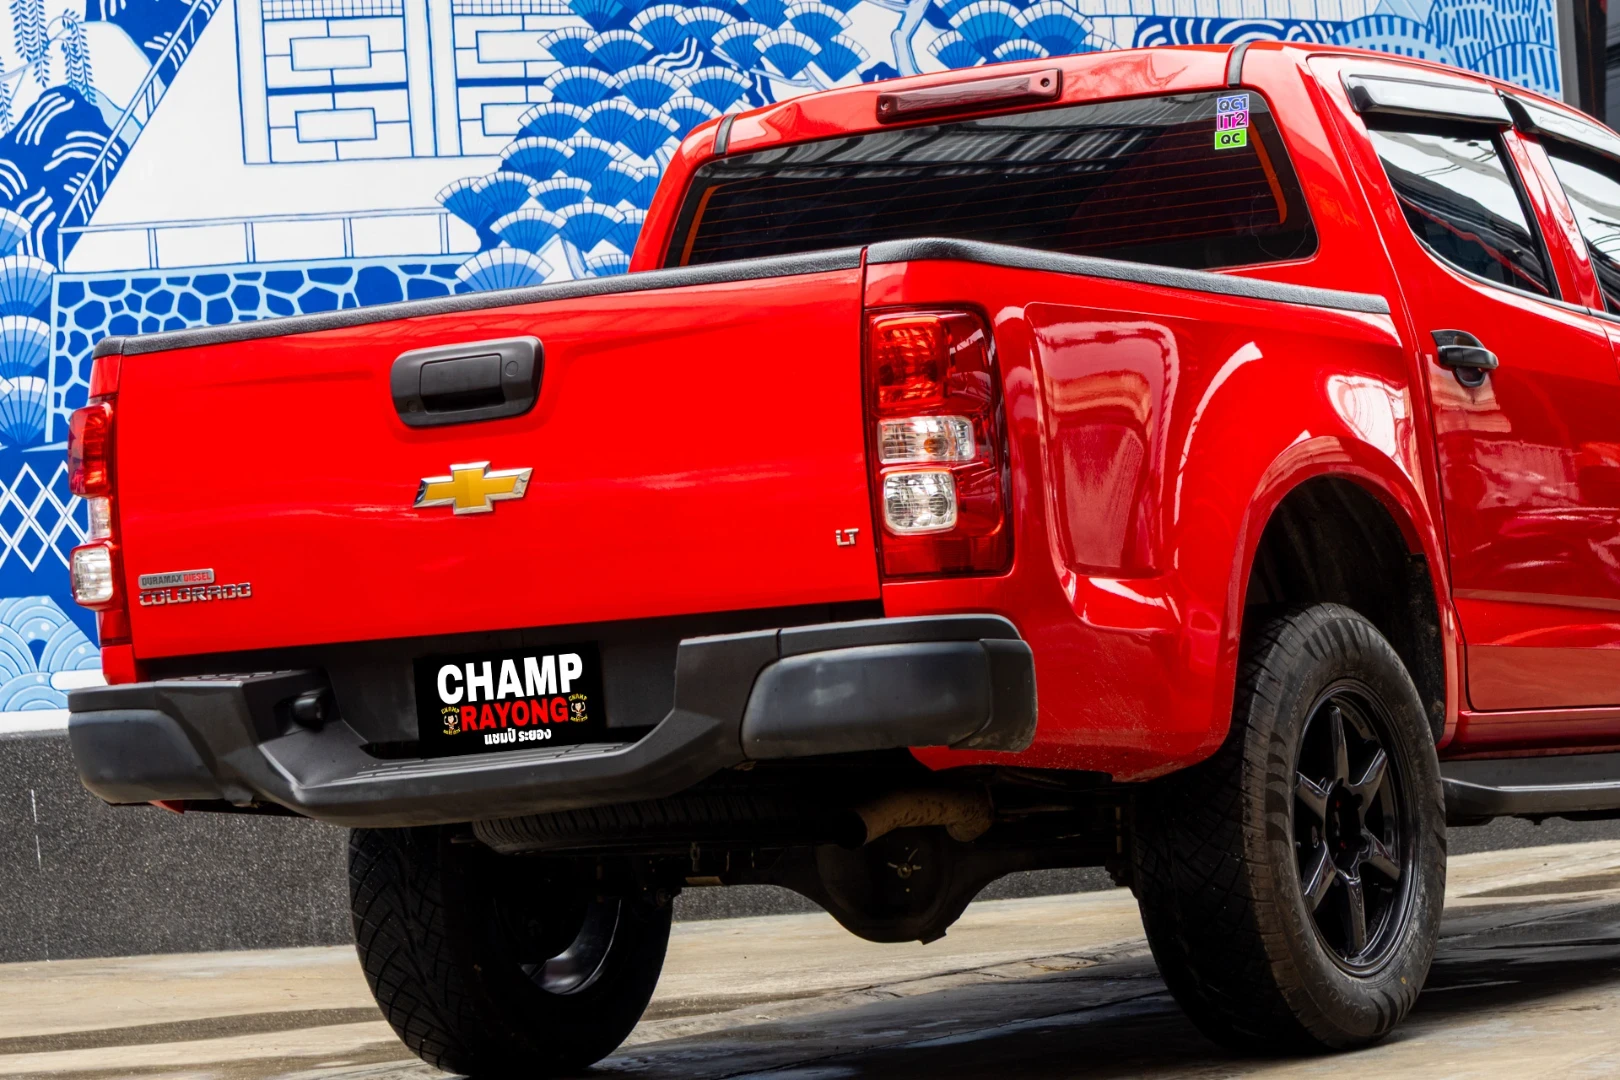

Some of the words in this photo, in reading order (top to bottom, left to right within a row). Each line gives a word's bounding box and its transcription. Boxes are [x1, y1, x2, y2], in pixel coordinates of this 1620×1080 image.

[1219, 97, 1247, 111] QC1
[1220, 112, 1246, 129] IT2
[1220, 132, 1241, 145] QC
[835, 528, 859, 546] LT
[142, 575, 181, 586] DURAMAX
[183, 572, 211, 582] DIESEL
[139, 582, 252, 606] COLORADO
